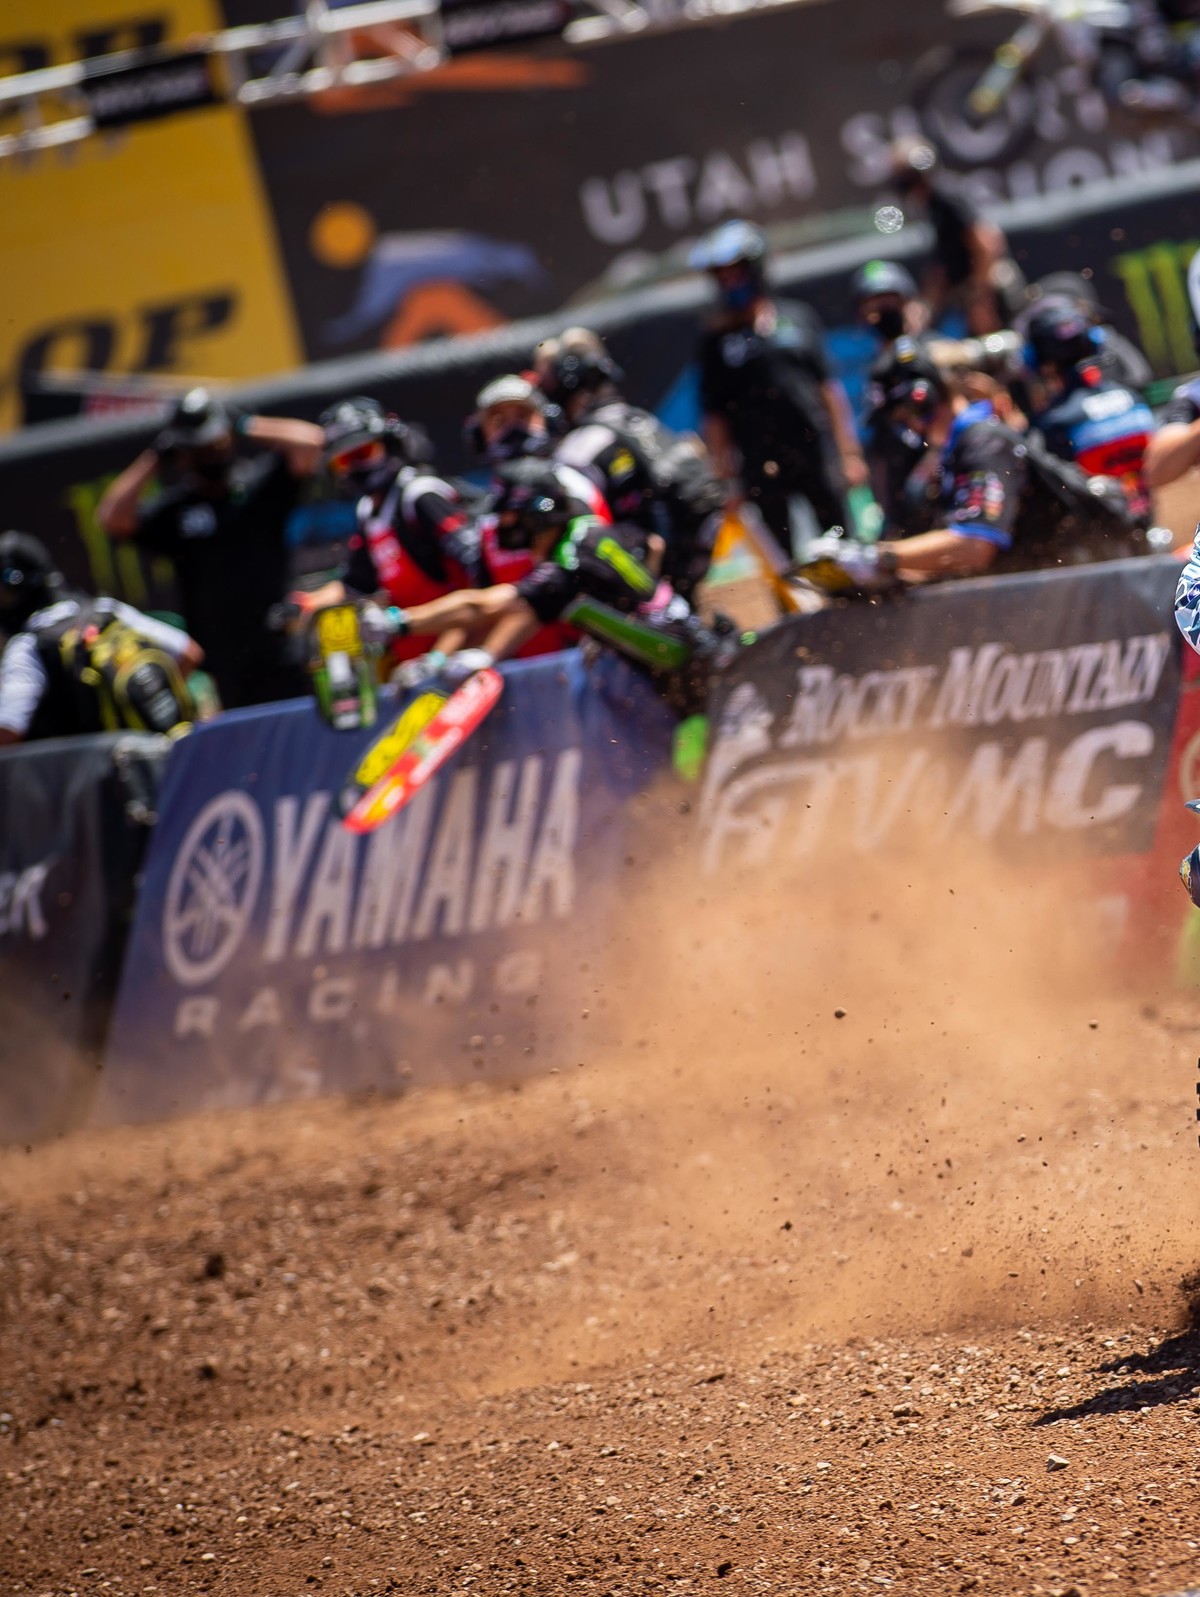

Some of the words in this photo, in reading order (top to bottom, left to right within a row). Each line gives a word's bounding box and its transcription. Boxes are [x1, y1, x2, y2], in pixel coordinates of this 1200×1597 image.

[580, 131, 817, 244] UTAH
[781, 664, 937, 748] ROCKY
[930, 633, 1171, 729] MOUNTAIN
[262, 748, 583, 964] YAMAHA
[173, 951, 543, 1038] RACING
